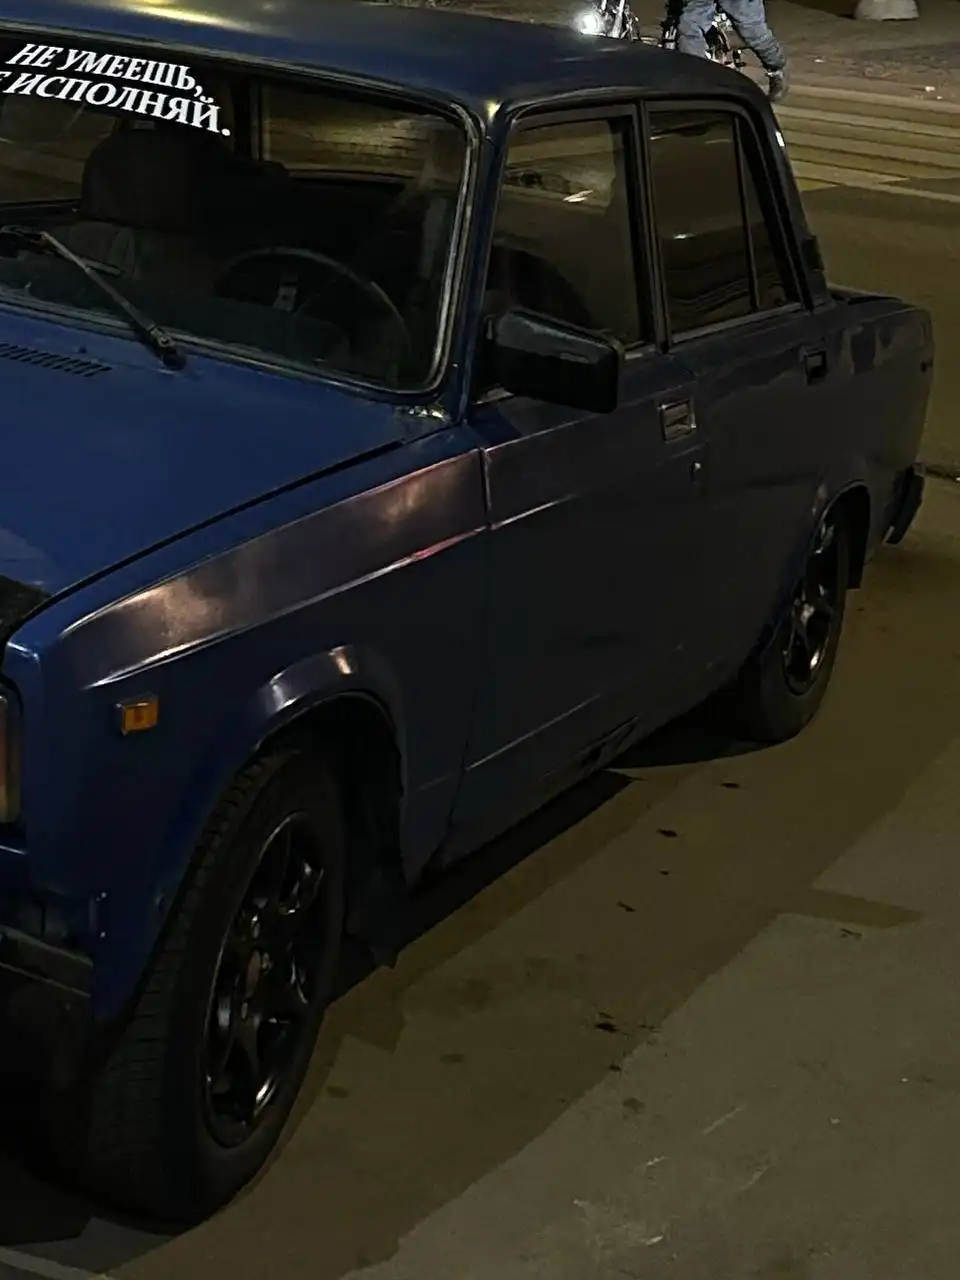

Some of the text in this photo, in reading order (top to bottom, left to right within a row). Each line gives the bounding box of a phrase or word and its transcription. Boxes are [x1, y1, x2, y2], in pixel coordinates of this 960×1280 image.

[5, 43, 203, 98] НЕ УМЕЕШЬ,
[3, 72, 231, 136] ИСПОЛНЯЙ.
